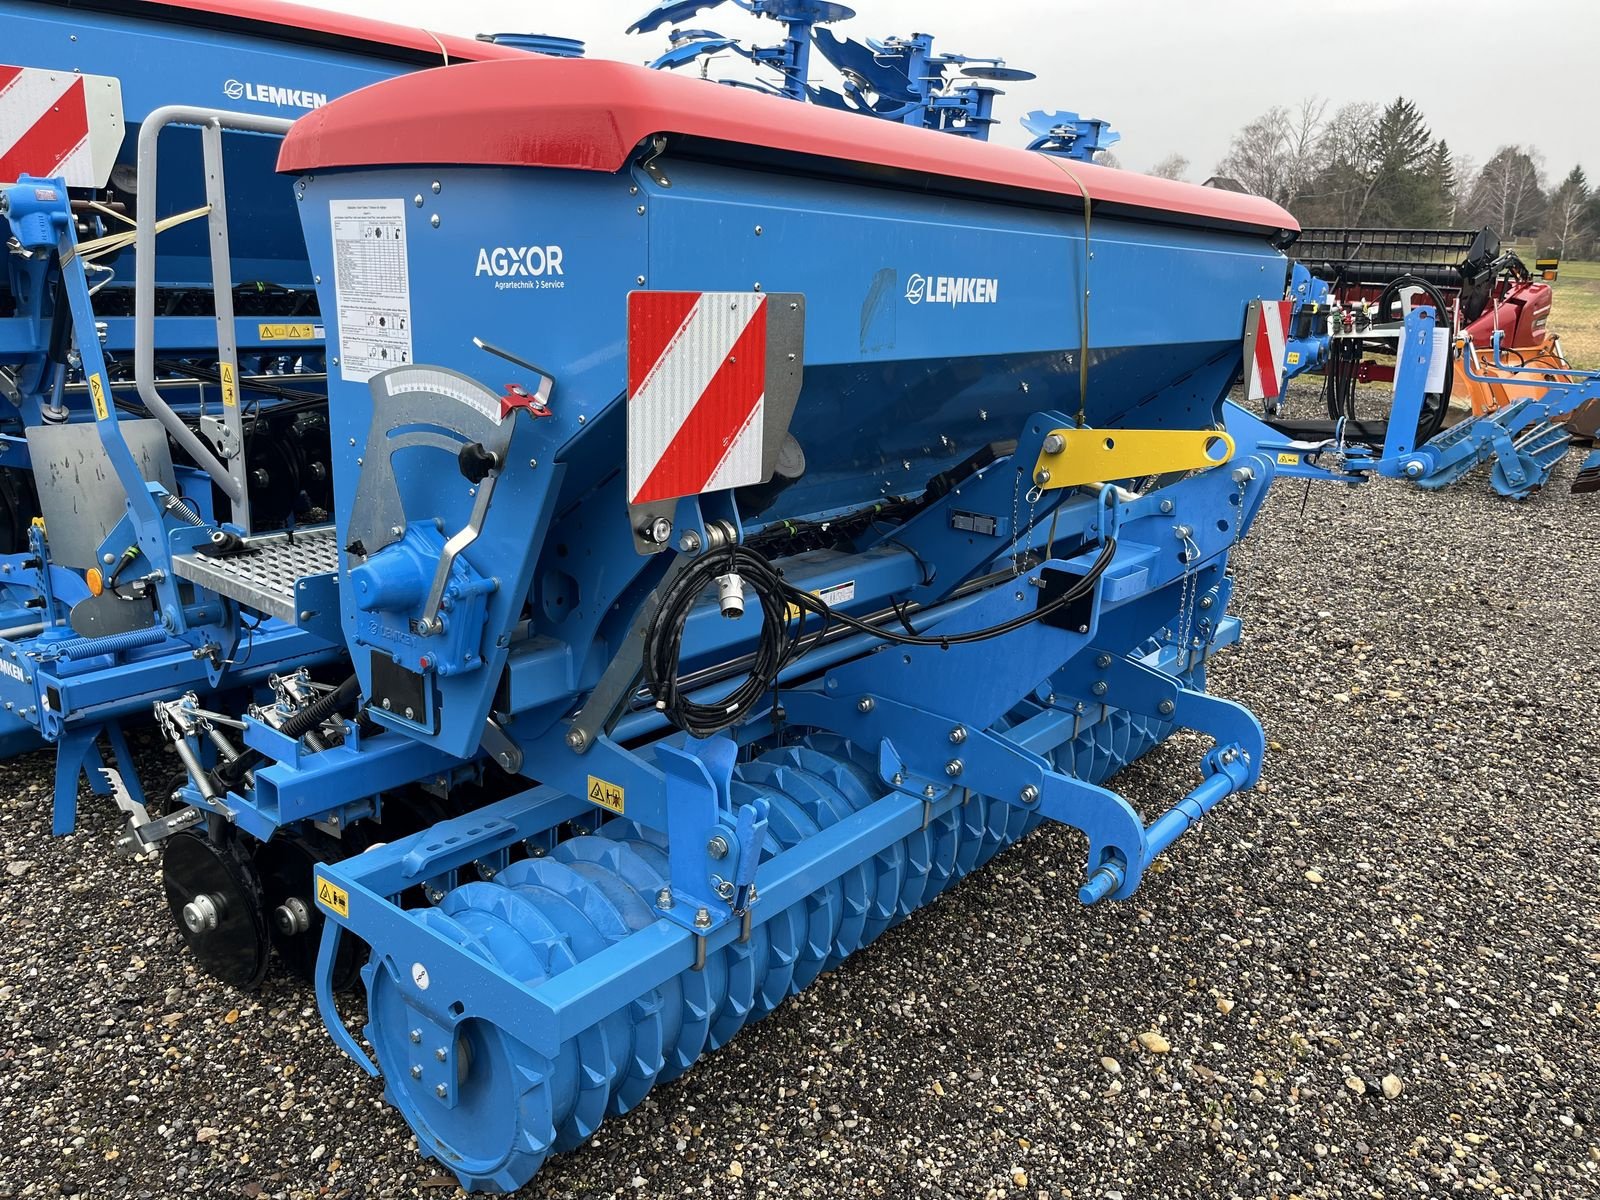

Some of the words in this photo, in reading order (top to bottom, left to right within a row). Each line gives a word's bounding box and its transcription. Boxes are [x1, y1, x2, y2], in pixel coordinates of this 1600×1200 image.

[245, 83, 327, 109] LEMKEN
[475, 246, 564, 276] AGXOR
[494, 280, 534, 290] Agrartechnik
[541, 280, 565, 289] Service
[926, 276, 998, 309] LEMKEN
